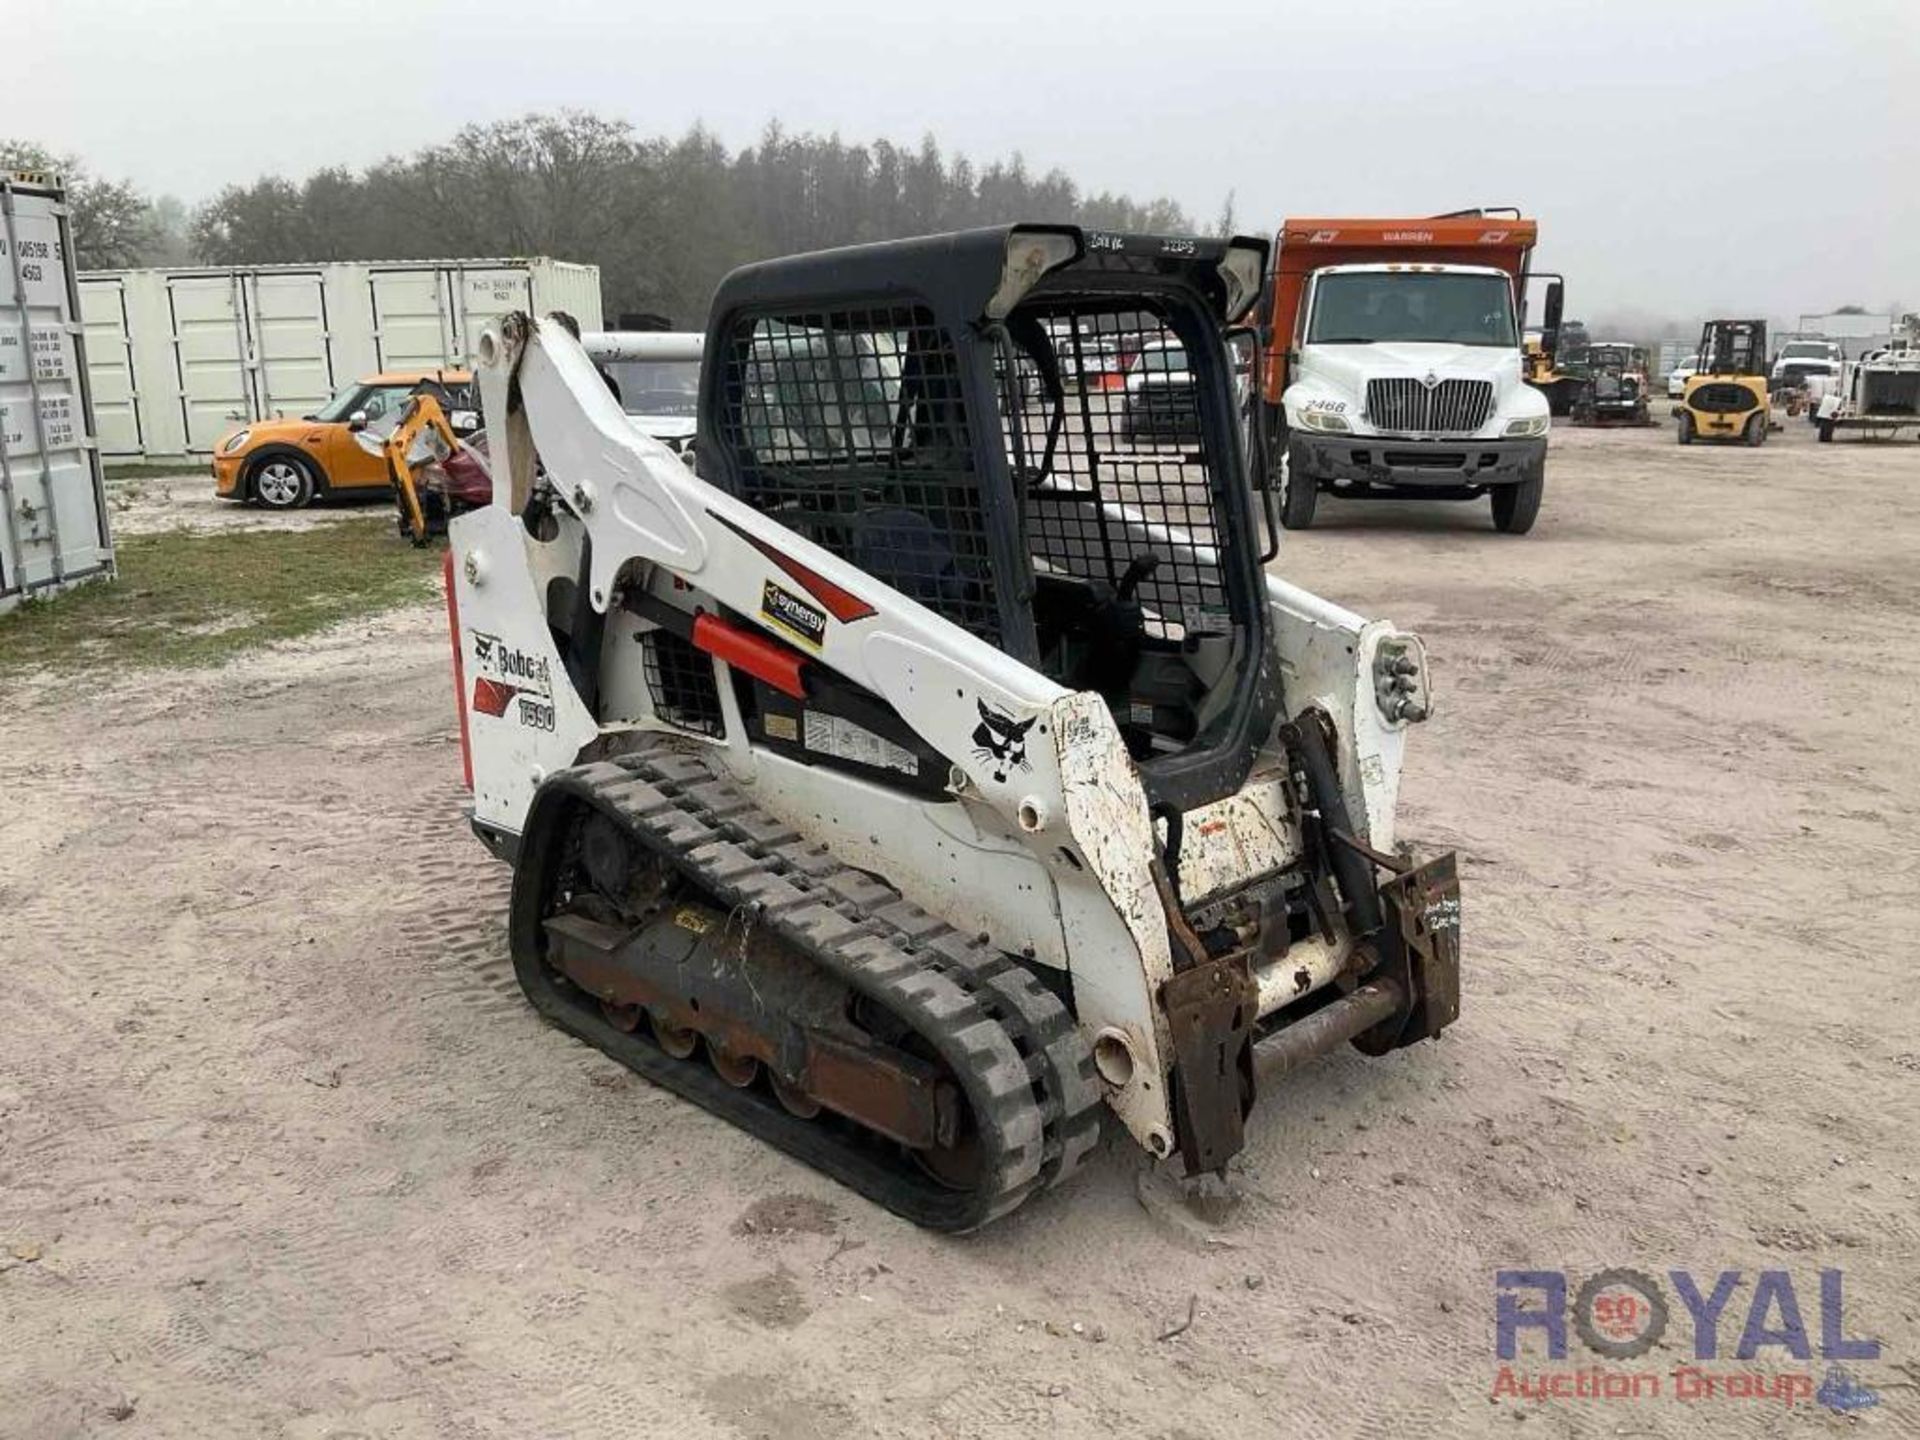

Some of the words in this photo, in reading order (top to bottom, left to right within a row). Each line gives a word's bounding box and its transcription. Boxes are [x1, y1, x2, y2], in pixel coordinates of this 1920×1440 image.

[1383, 230, 1434, 242] WARREN
[1304, 399, 1346, 413] 2468
[778, 593, 825, 632] synergy
[498, 645, 550, 683] Bobcat
[518, 698, 555, 733] T590
